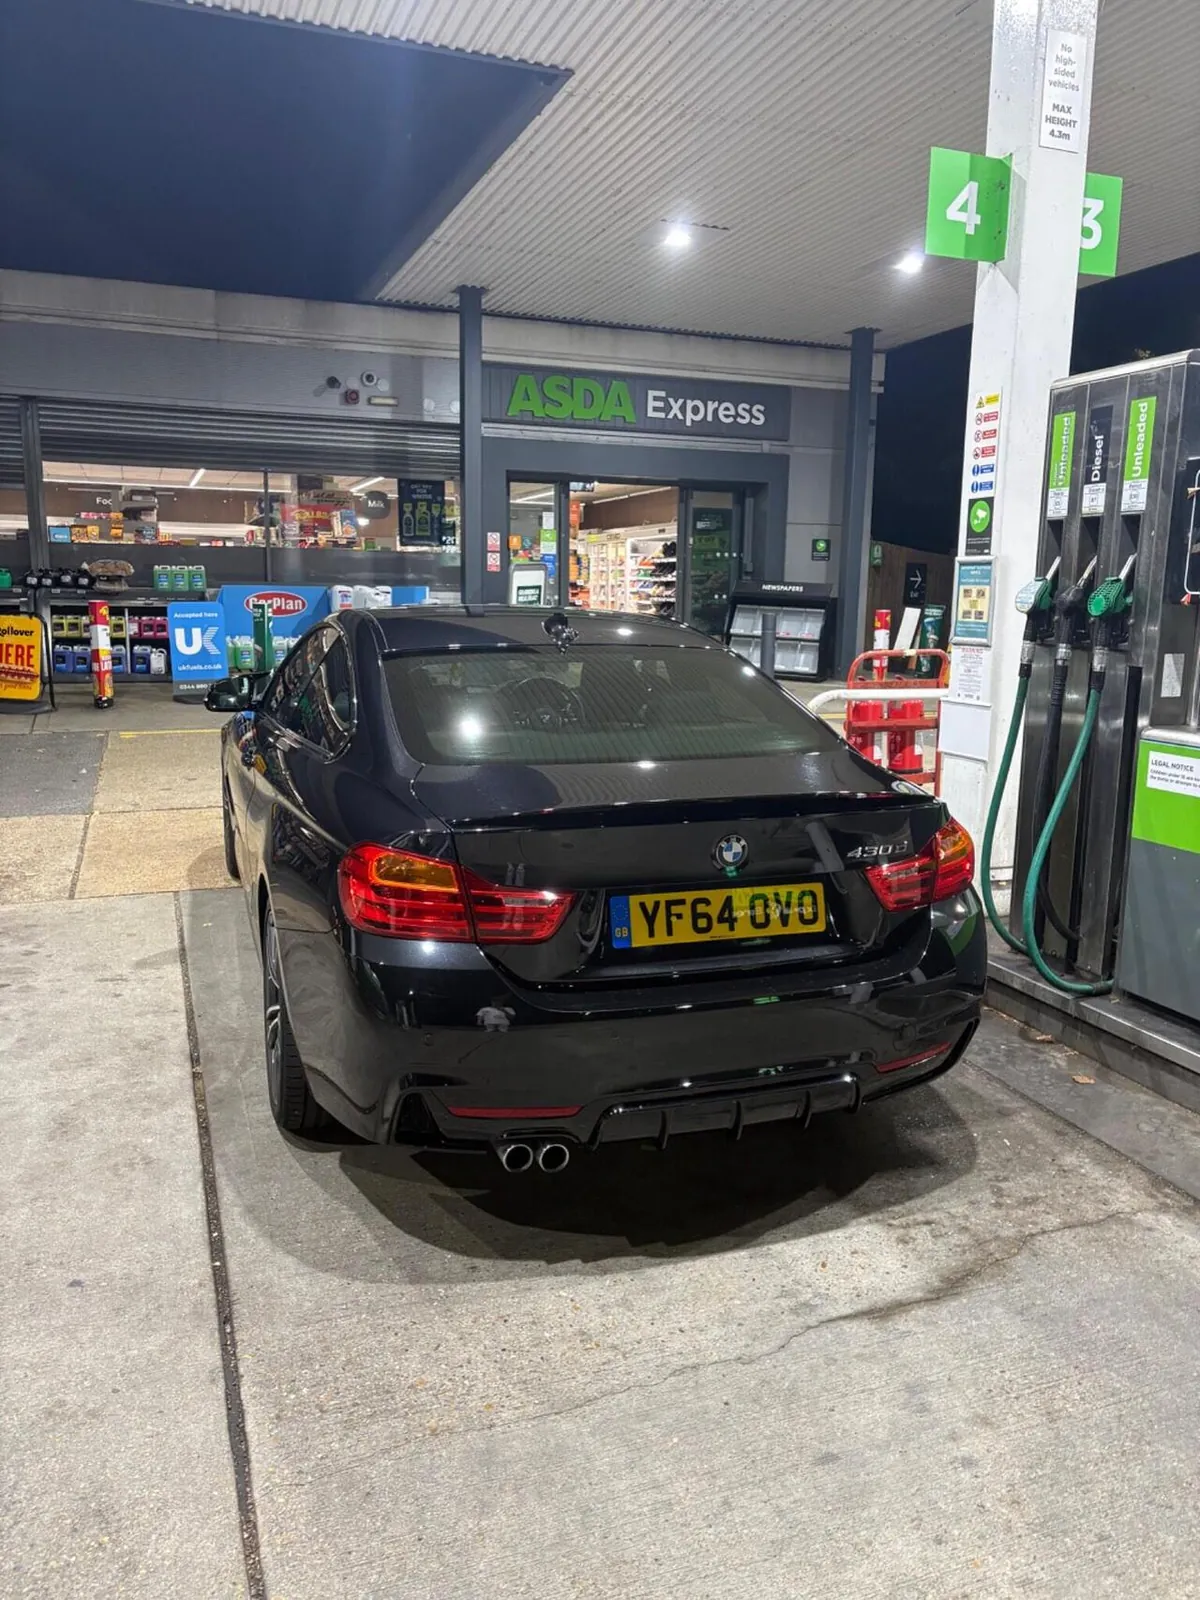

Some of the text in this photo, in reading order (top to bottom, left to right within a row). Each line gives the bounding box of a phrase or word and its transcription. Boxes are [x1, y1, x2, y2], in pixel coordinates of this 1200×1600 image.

[1061, 43, 1072, 53] No
[1055, 54, 1076, 67] high-
[1054, 68, 1075, 79] sided
[1048, 79, 1079, 92] vehicles
[1052, 102, 1072, 115] MAX
[1045, 114, 1078, 129] HEIGHT
[1049, 128, 1071, 141] 4.3m
[946, 181, 981, 235] 4
[1080, 198, 1104, 250] 3
[507, 374, 765, 426] ASDA Express
[1132, 402, 1148, 477] Unleaded
[1091, 435, 1104, 482] Diesel
[368, 500, 385, 508] Milk
[762, 584, 804, 592] NEWSPAPERS
[0, 626, 34, 638] ollover
[174, 627, 221, 655] UK
[1151, 760, 1194, 772] LEGAL NOTICE
[639, 895, 738, 939] YF64
[749, 889, 819, 930] OVO
[615, 927, 629, 938] GB
